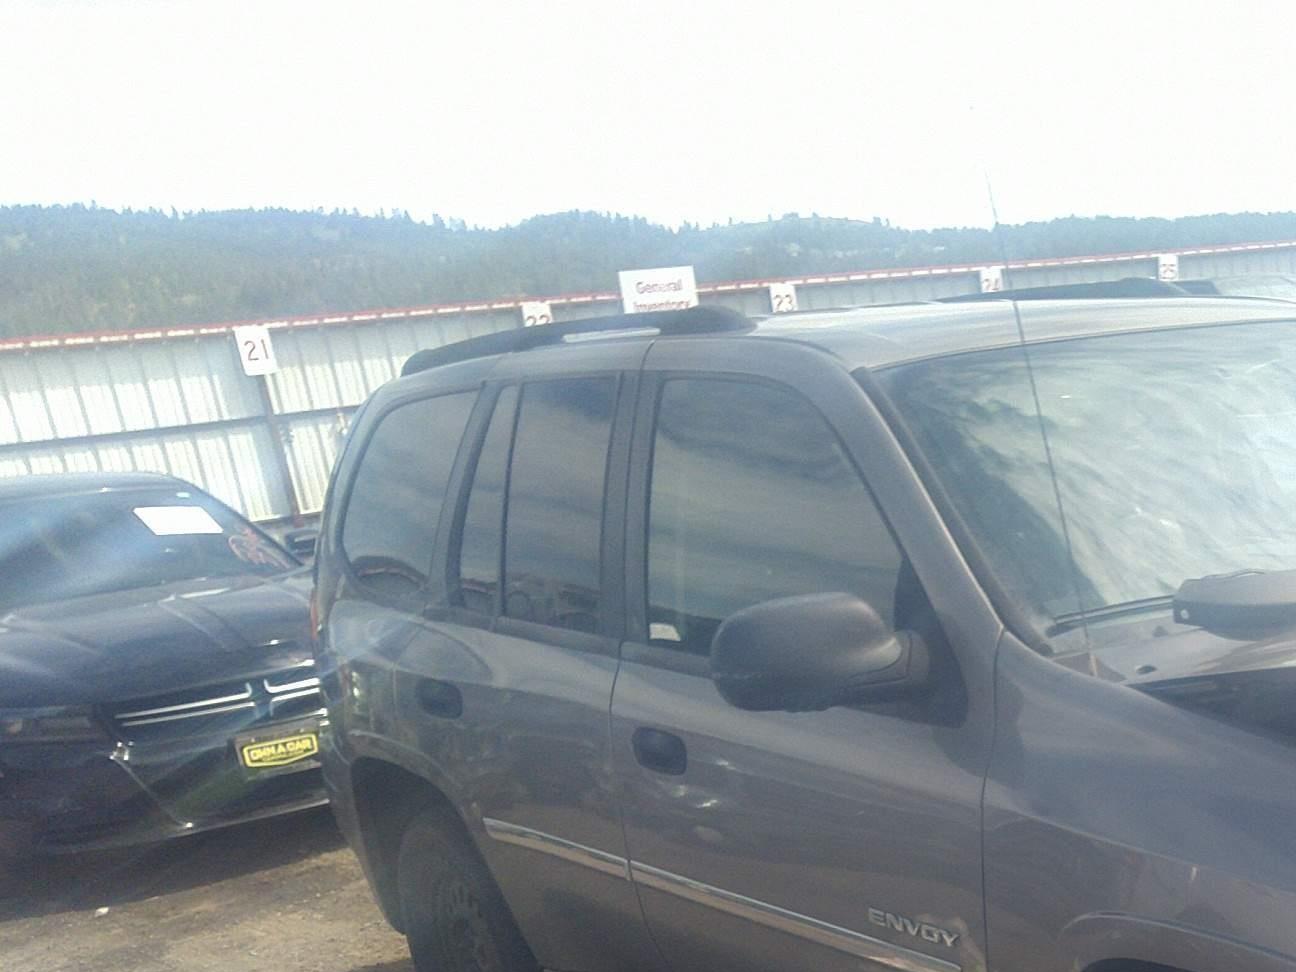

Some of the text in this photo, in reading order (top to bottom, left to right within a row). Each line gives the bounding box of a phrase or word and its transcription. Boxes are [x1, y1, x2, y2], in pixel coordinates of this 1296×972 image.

[636, 279, 682, 294] General
[243, 338, 269, 361] 21
[867, 906, 960, 947] ENVOY
